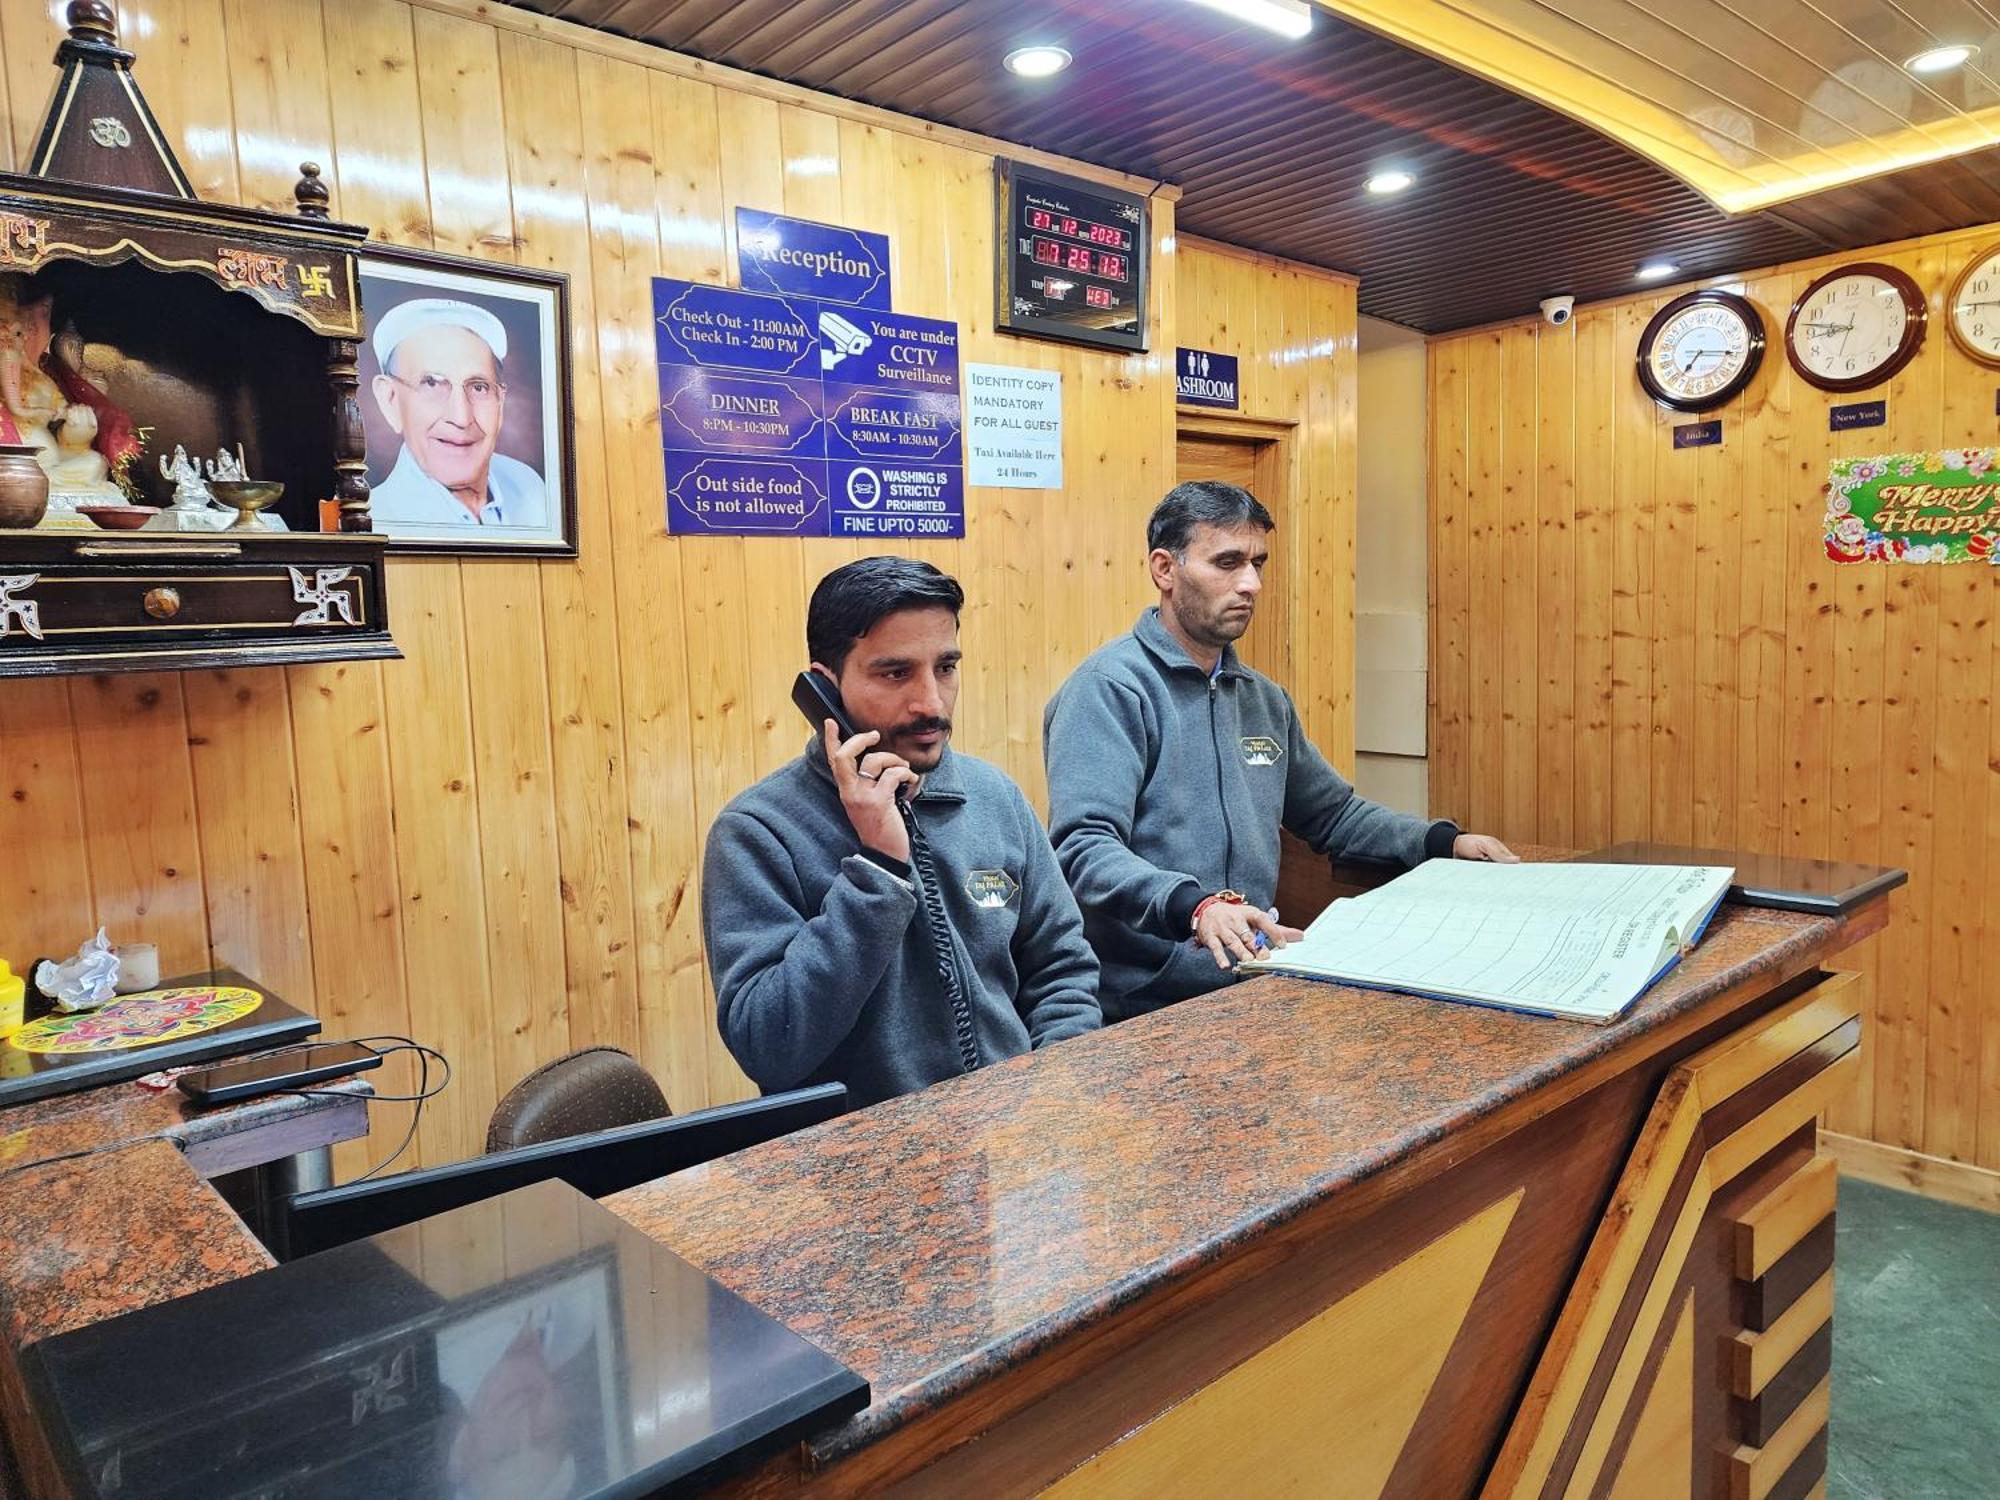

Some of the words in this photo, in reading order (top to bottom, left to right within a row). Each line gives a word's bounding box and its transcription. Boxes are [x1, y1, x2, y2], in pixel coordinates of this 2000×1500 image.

[1033, 212, 1050, 228] 27
[1062, 220, 1077, 234] 12
[1091, 226, 1120, 246] 2023
[761, 245, 872, 279] Reception
[1846, 283, 1860, 296] 12
[1871, 285, 1876, 297] 1
[1972, 279, 1989, 295] 10
[1827, 291, 1836, 304] 11
[1884, 296, 1894, 309] 2
[1810, 307, 1824, 321] 10
[671, 307, 713, 325] Check
[717, 313, 741, 329] Out
[752, 318, 805, 338] 11:00AM
[1973, 322, 1984, 337] 8
[681, 327, 722, 344] Check
[726, 332, 740, 346] In
[750, 335, 775, 350] 2:00
[778, 339, 798, 353] PM
[870, 321, 896, 338] You
[899, 329, 918, 341] are
[920, 331, 955, 346] under
[1806, 328, 1816, 340] 9
[890, 345, 938, 366] CCTV
[1811, 345, 1820, 357] 8
[1825, 356, 1834, 370] 7
[1845, 358, 1856, 372] 6
[878, 364, 952, 385] Surveillance
[972, 373, 1024, 388] IDENTITY
[1026, 380, 1055, 392] COPY
[1176, 375, 1235, 399] ASHROOM
[711, 394, 781, 414] DINNER
[973, 395, 1044, 410] MANDATORY
[851, 407, 900, 425] BREAK
[904, 411, 938, 428] FAST
[974, 416, 998, 428] FOR
[1001, 418, 1022, 429] ALL
[1024, 420, 1059, 431] GUEST
[1836, 413, 1857, 423] New
[1859, 410, 1880, 420] York
[703, 418, 733, 432] 8:PM
[744, 421, 789, 436] 10:30PM
[852, 430, 890, 443] 8:30AM
[899, 433, 939, 447] 10:30AM
[696, 475, 729, 492] Out
[732, 477, 765, 493] side
[768, 479, 803, 495] food
[882, 470, 936, 484] WASHING
[937, 473, 948, 485] IS
[890, 485, 941, 497] STRICTLY
[1879, 484, 1994, 512] Merry
[696, 496, 710, 512] is
[715, 499, 740, 513] not
[745, 498, 805, 514] allowed
[886, 499, 946, 512] PROHIBITED
[843, 517, 875, 532] FINE
[878, 517, 915, 533] UPTO
[917, 519, 954, 533] 5000/-
[1872, 508, 1994, 536] Happy
